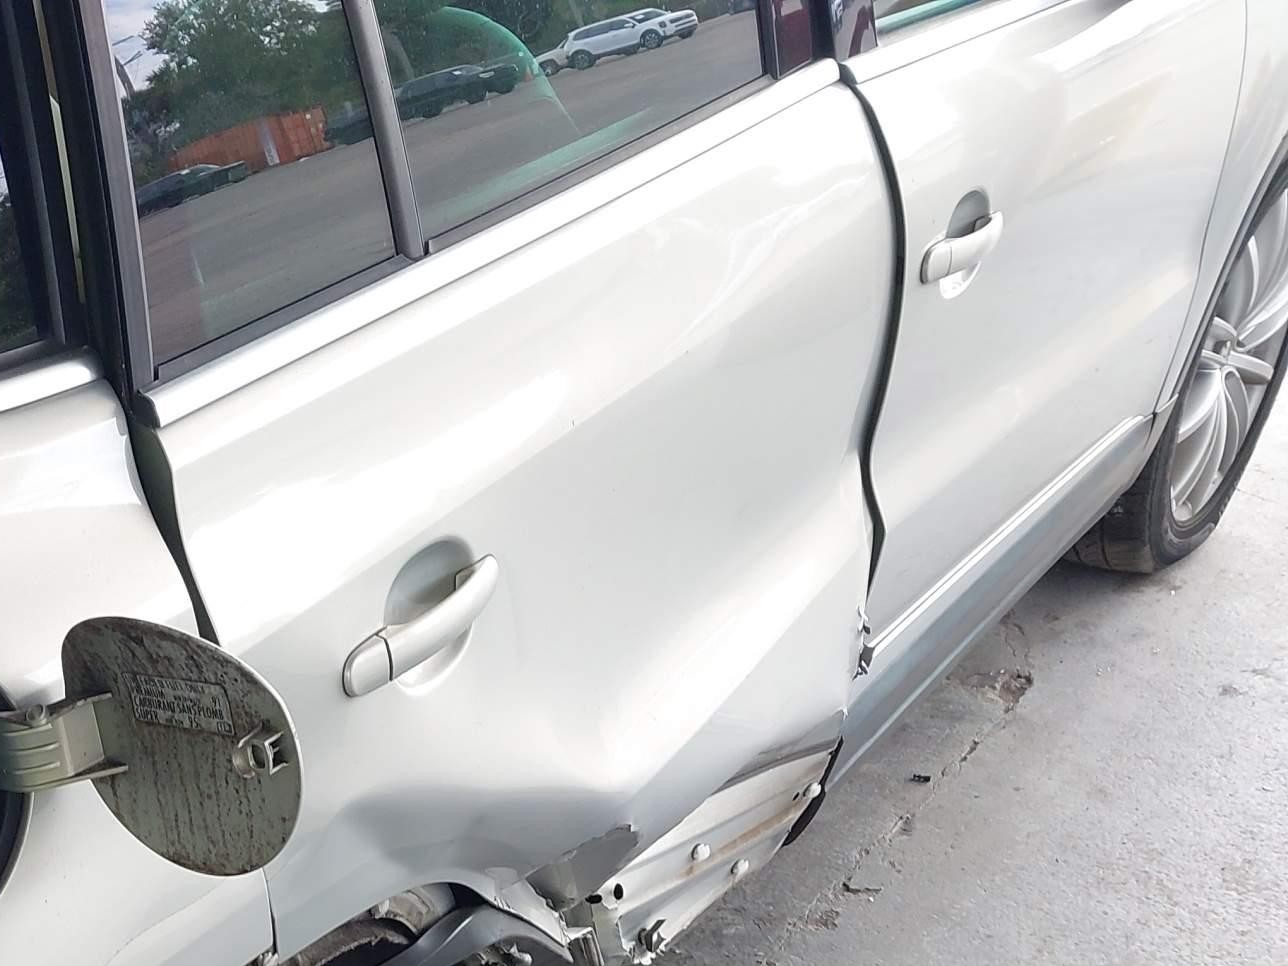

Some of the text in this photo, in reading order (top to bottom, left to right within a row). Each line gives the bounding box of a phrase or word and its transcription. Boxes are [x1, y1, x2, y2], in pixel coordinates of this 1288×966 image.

[134, 695, 175, 713] CARBURANT
[177, 702, 197, 716] SANS
[198, 705, 224, 720] PLOMB
[135, 707, 159, 722] SUPER
